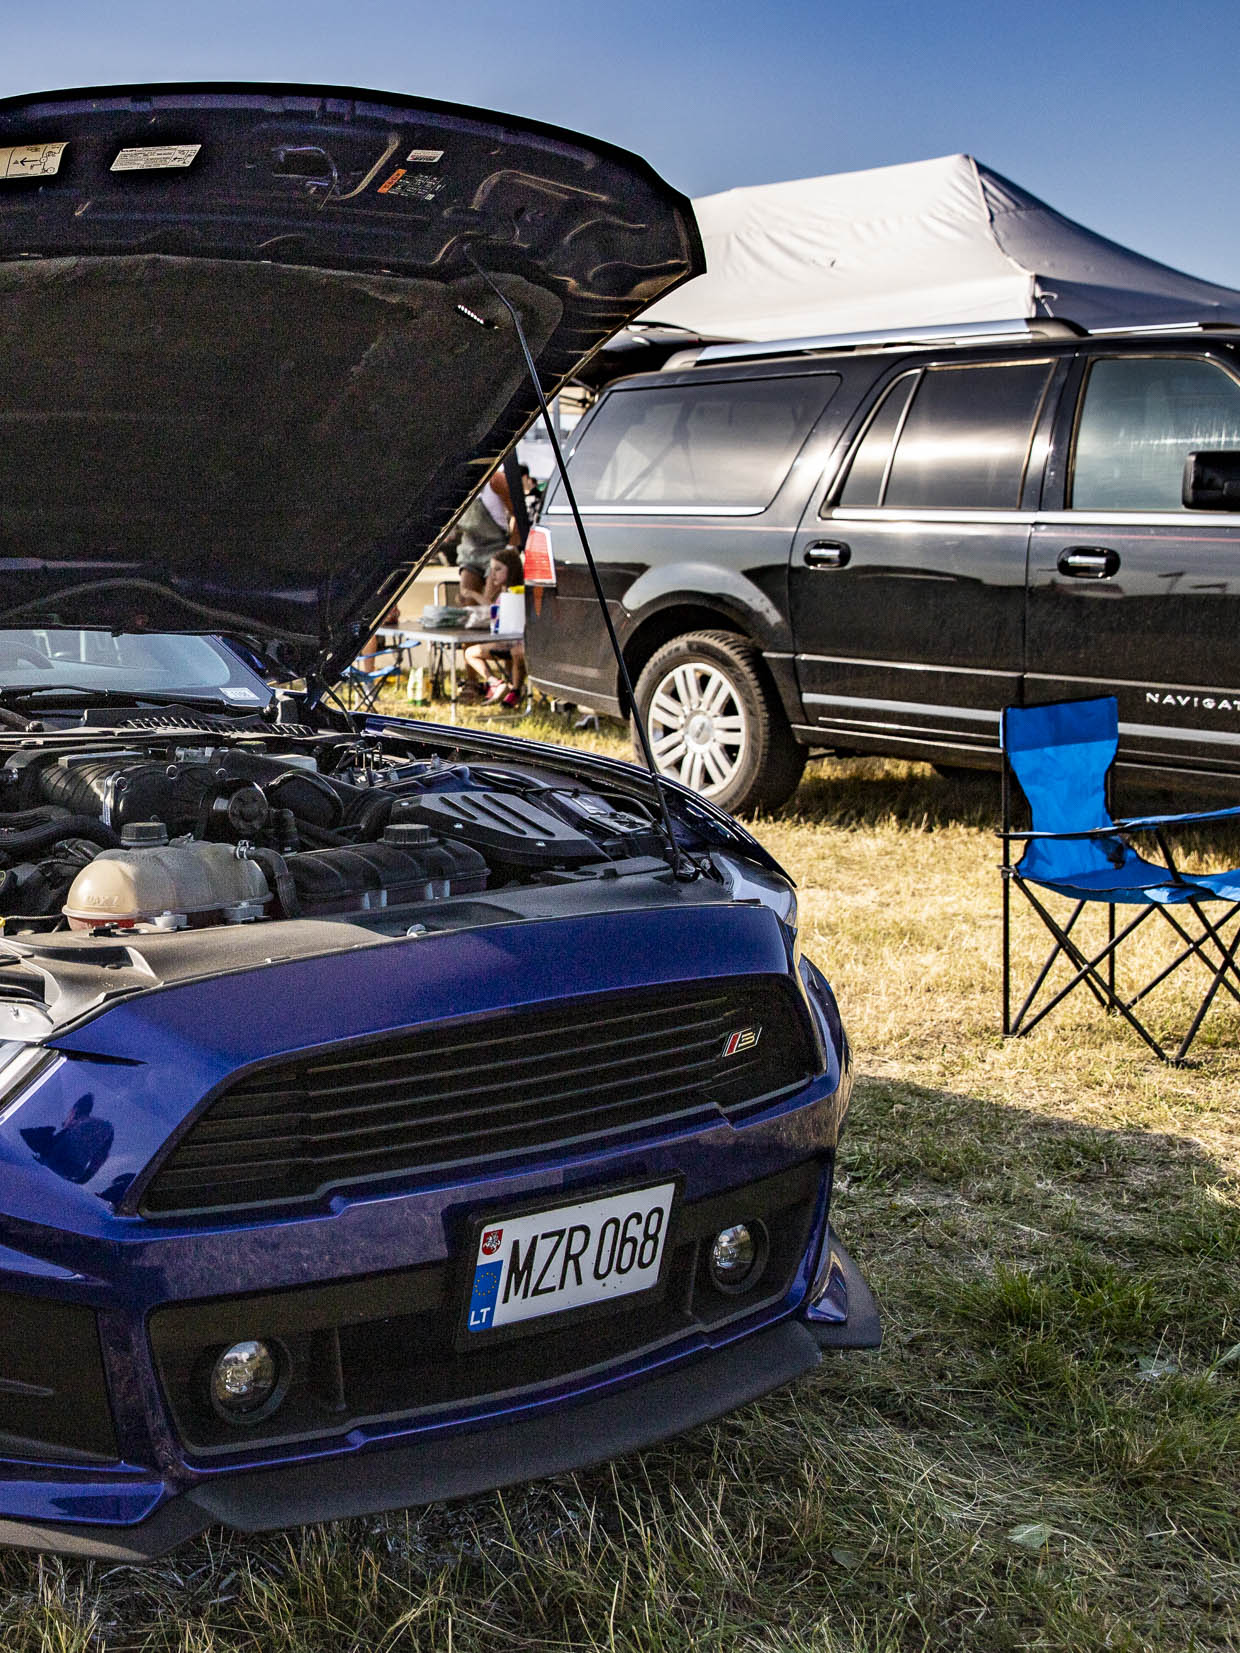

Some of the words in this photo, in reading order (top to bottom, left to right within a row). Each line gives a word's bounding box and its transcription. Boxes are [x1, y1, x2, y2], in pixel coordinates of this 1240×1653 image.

[502, 1224, 591, 1304] MZR
[592, 1206, 665, 1281] 068
[469, 1307, 491, 1326] LT
